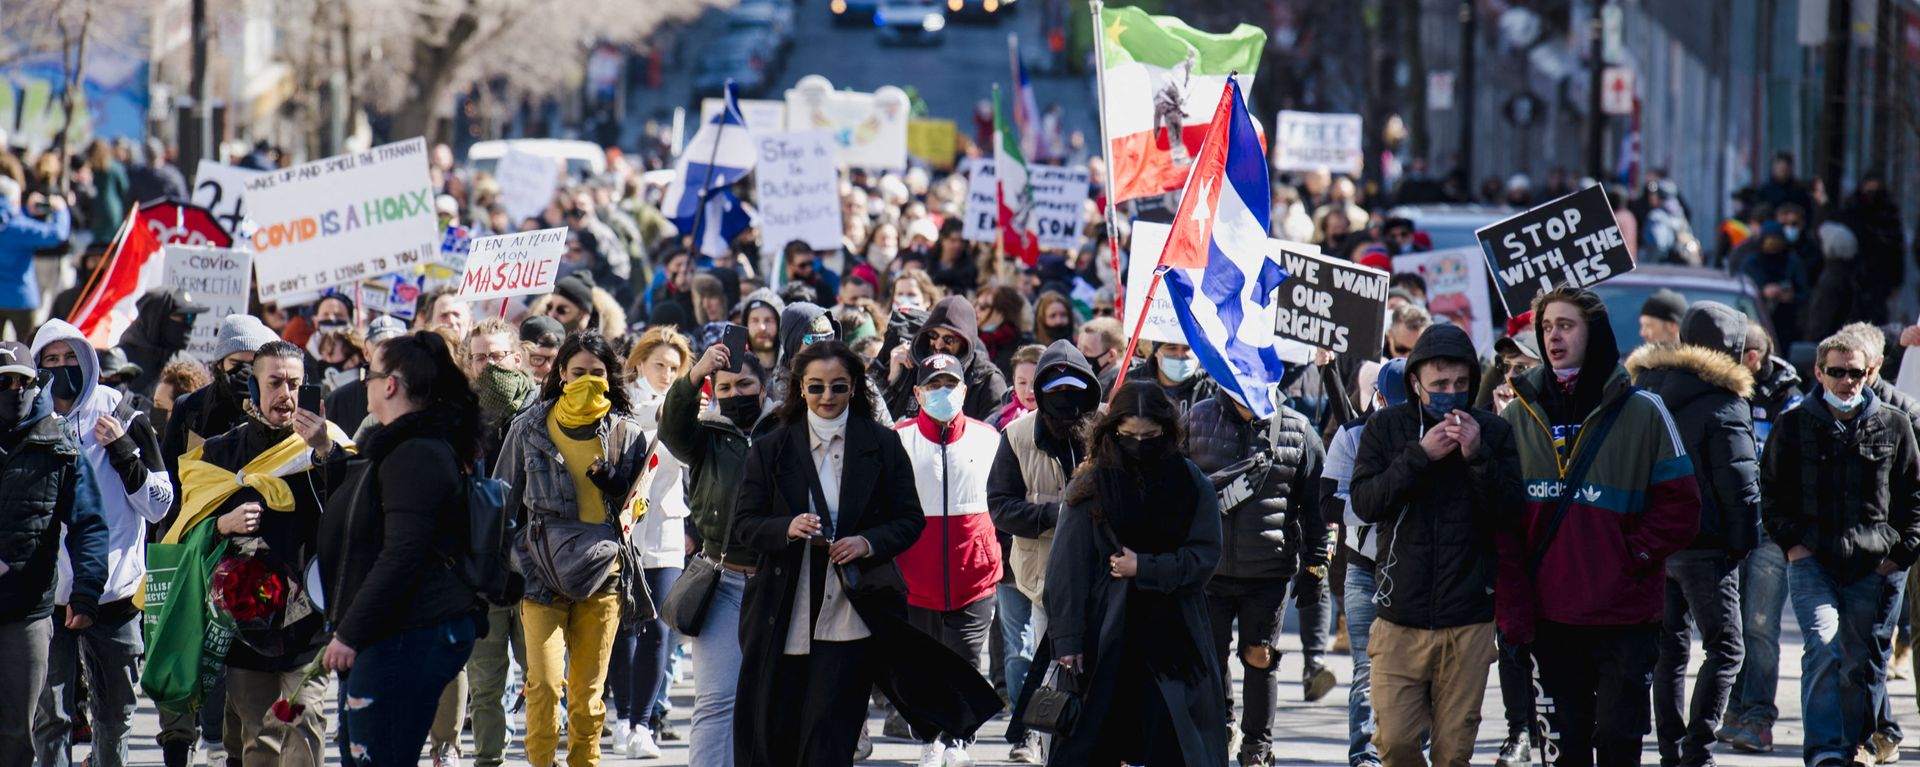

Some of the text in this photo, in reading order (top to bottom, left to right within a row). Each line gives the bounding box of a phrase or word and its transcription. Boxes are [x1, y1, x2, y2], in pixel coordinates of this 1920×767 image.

[245, 176, 275, 191] WAKE
[279, 172, 296, 182] UP
[299, 165, 321, 181] AND
[326, 158, 356, 173] SMELL
[359, 153, 375, 166] THE
[252, 188, 431, 252] COVID IS A HOAX
[1503, 208, 1582, 260] STOP
[495, 251, 528, 262] MON
[528, 232, 562, 247] PLEIN
[1574, 225, 1624, 258] THE
[280, 274, 308, 292] GOV'T
[315, 271, 328, 283] IS
[334, 264, 366, 281] LYING
[372, 258, 387, 272] TO
[395, 249, 418, 265] YOU
[460, 259, 553, 296] MASQUE
[1284, 253, 1389, 302] WE WANT
[1292, 284, 1334, 319] OUR
[1527, 481, 1581, 499] adid
